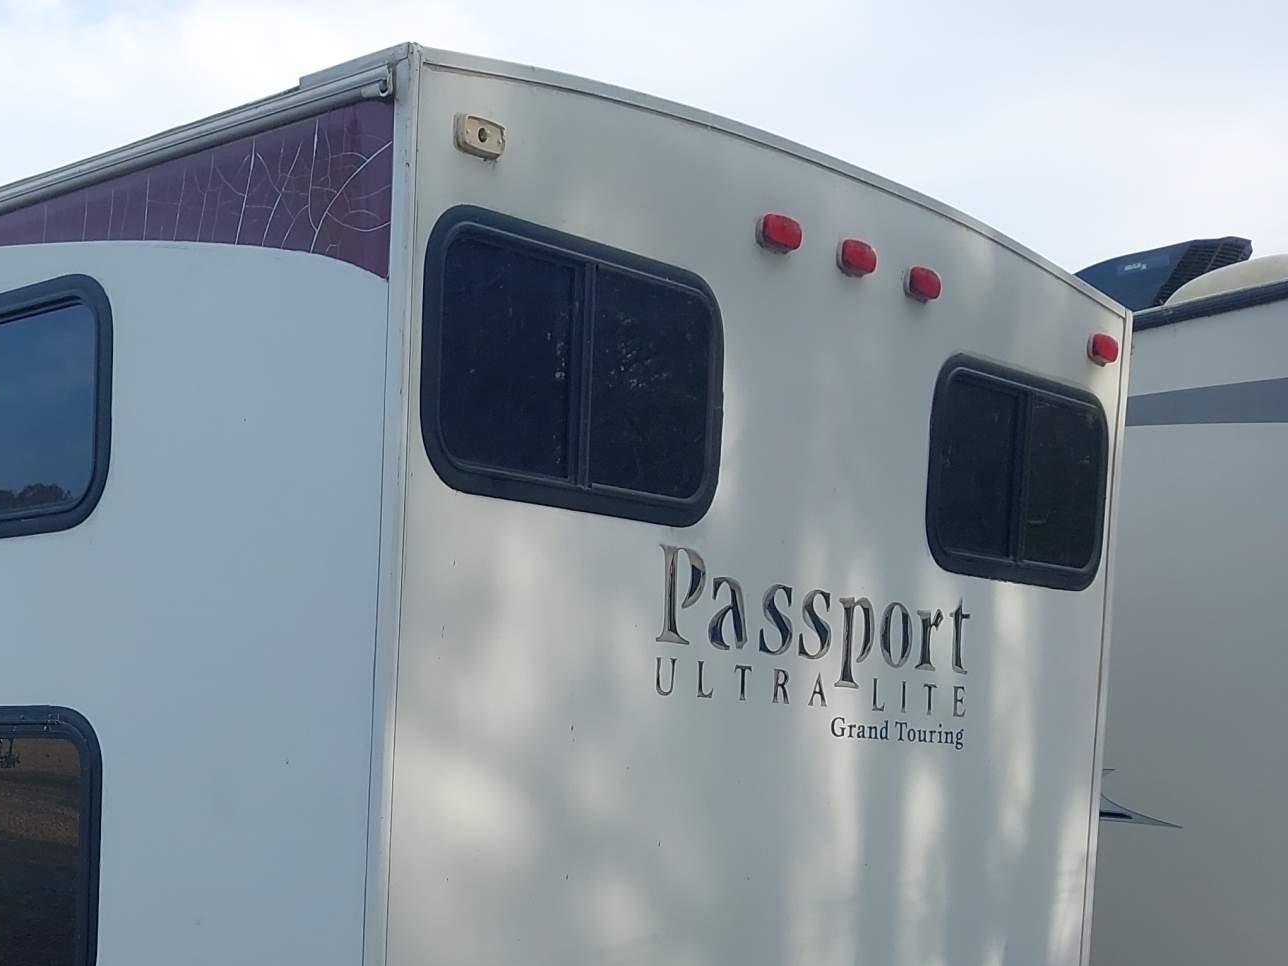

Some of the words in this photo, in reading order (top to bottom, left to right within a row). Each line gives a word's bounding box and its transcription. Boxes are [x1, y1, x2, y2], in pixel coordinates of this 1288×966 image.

[655, 543, 972, 689] Passport
[655, 656, 828, 708] ULTRA
[871, 678, 967, 718] LITE
[830, 716, 890, 741] Grand
[895, 721, 965, 751] Touring
